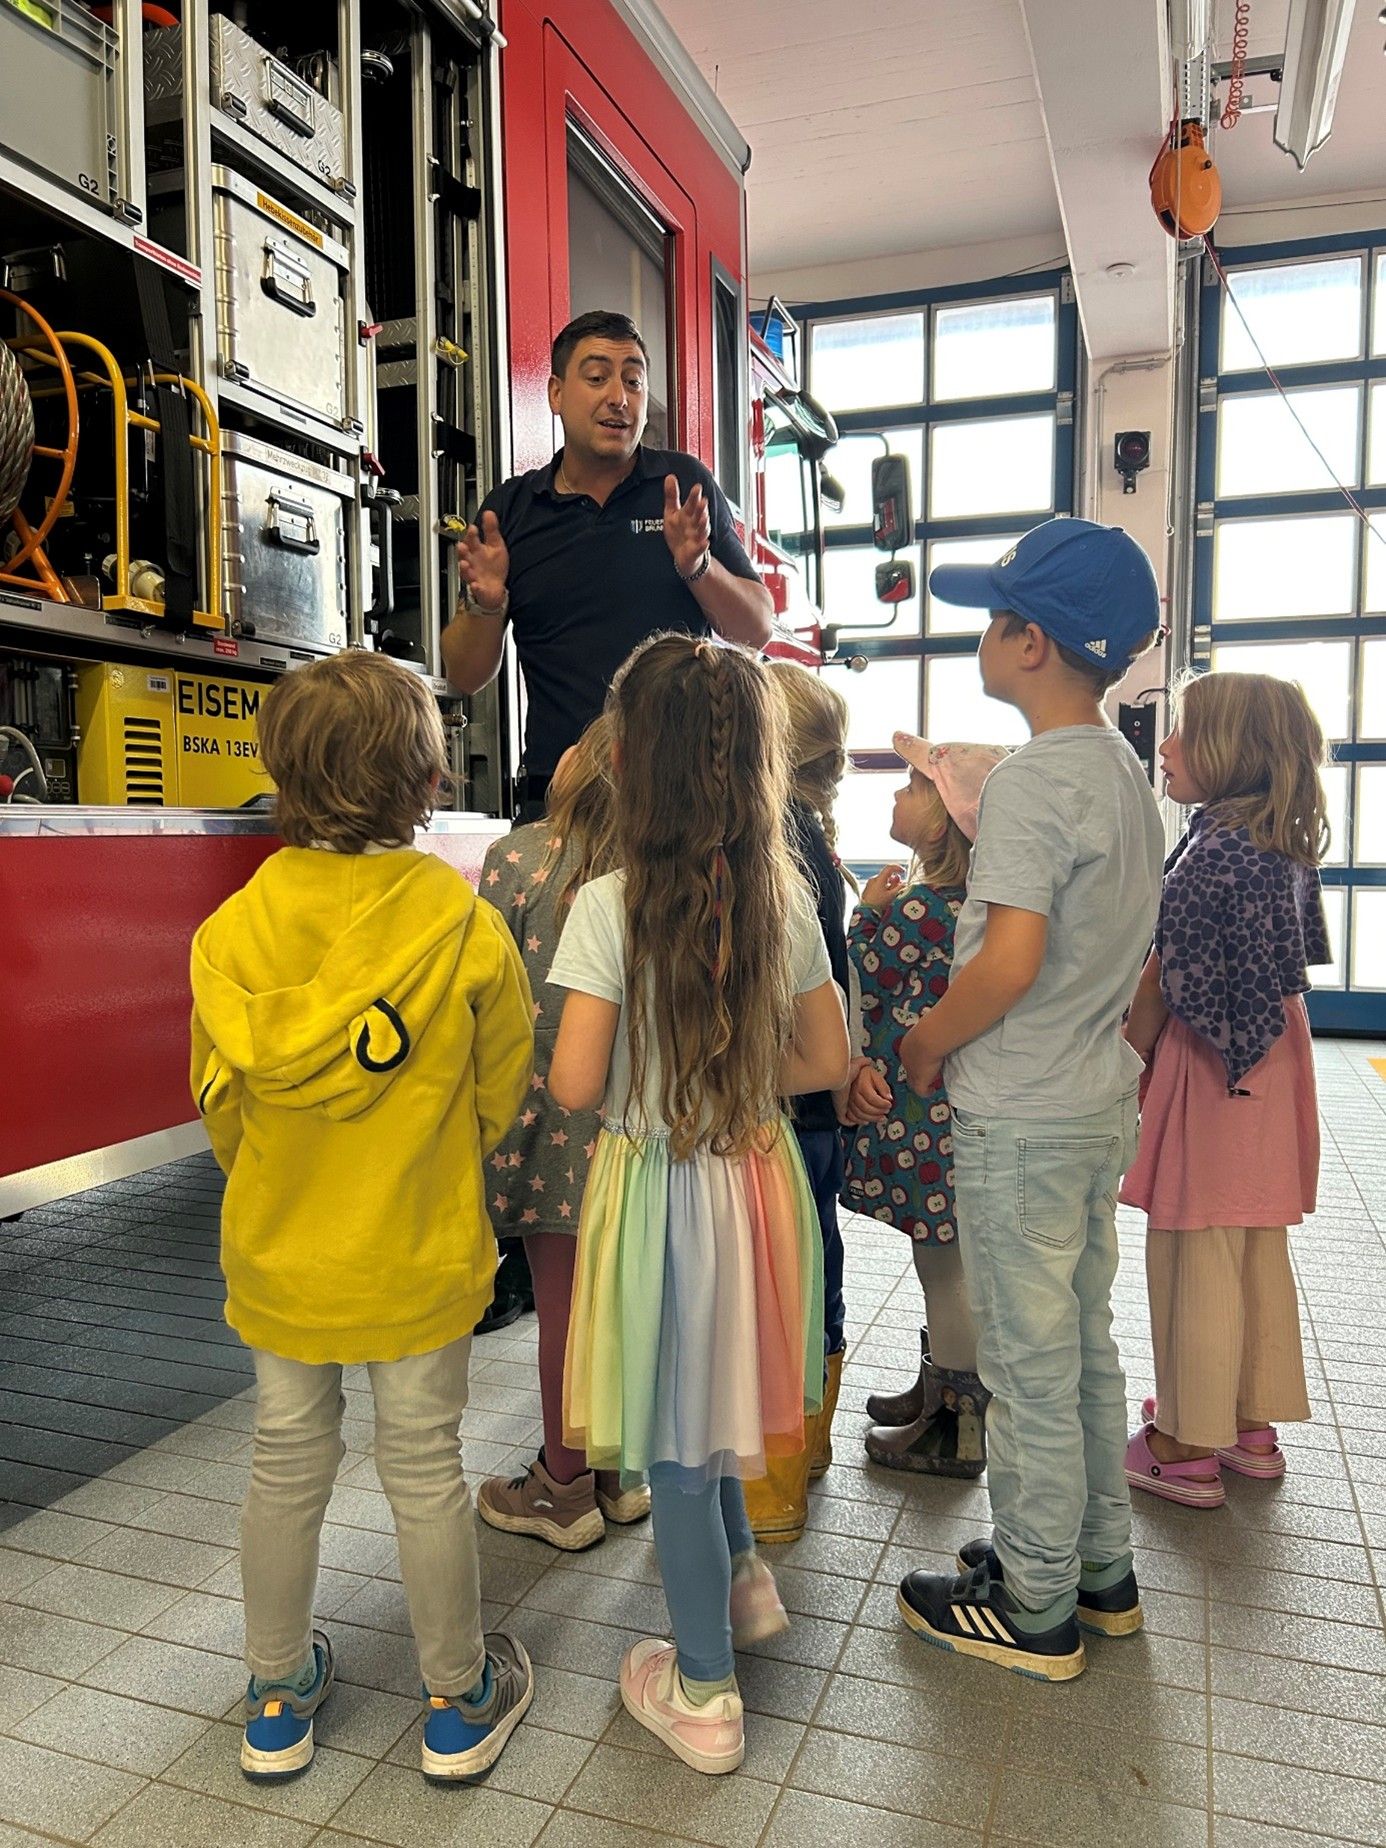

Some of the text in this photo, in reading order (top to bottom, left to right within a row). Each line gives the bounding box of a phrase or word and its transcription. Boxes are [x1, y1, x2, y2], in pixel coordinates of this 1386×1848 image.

[318, 160, 331, 179] G2
[79, 173, 99, 195] G2
[326, 402, 339, 418] G2
[328, 633, 342, 646] G2
[1084, 642, 1107, 658] adidas
[183, 735, 220, 756] BSKA
